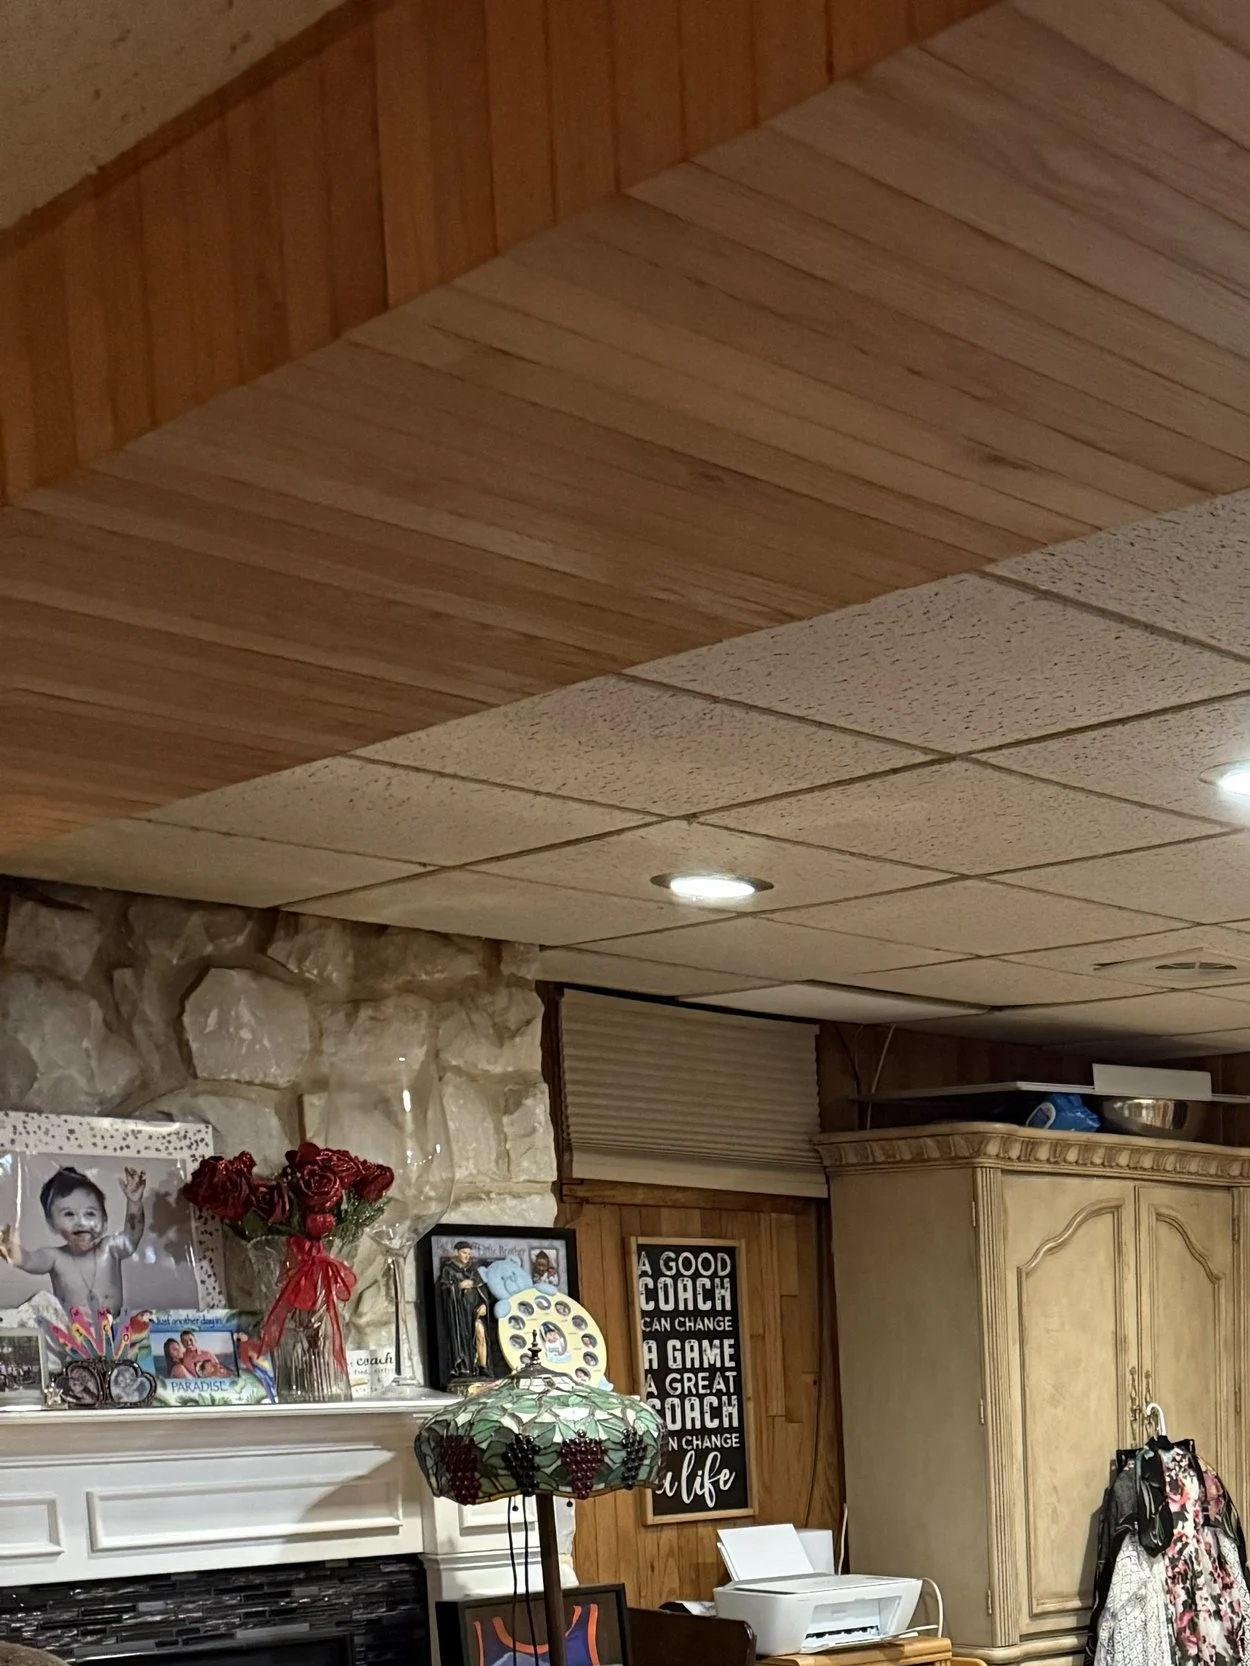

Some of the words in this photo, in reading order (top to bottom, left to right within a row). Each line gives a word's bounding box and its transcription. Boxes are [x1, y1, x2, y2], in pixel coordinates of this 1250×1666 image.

[638, 1252, 652, 1276] A
[660, 1252, 732, 1276] GOOD
[639, 1276, 732, 1312] COACH
[641, 1316, 671, 1332] CAN
[675, 1316, 733, 1332] CHANGE
[643, 1339, 659, 1370] A
[667, 1338, 736, 1368] GAME
[171, 1380, 229, 1392] PARADISE
[645, 1374, 658, 1396] A
[665, 1371, 737, 1396] GREAT
[682, 1433, 740, 1450] CHANGE
[681, 1450, 736, 1508] life
